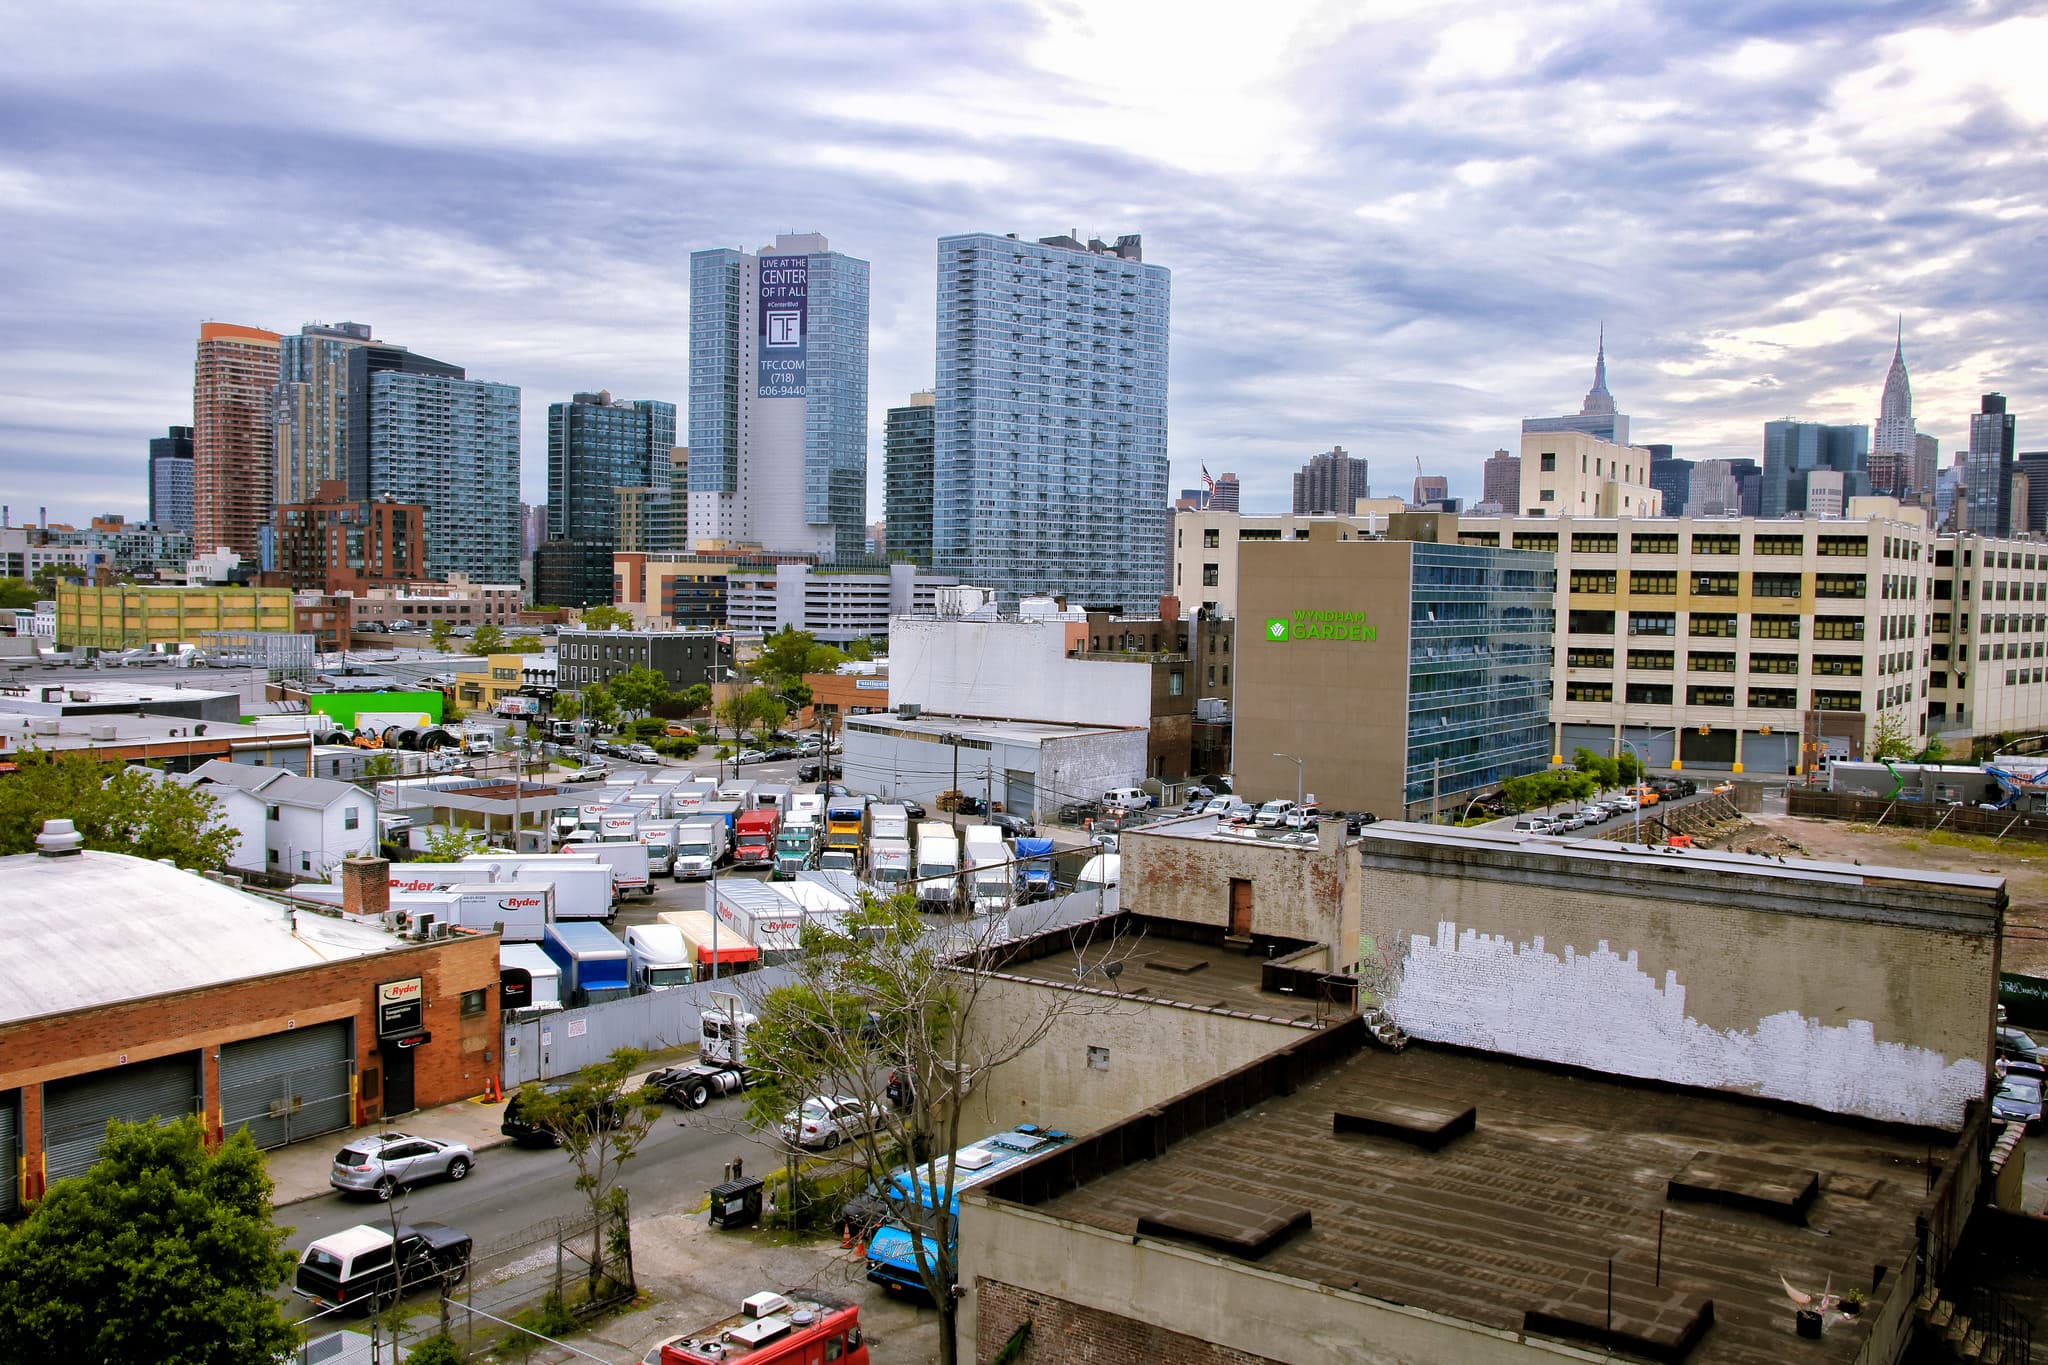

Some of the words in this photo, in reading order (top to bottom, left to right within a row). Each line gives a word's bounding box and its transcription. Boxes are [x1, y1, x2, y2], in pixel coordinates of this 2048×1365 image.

[762, 259, 778, 268] LIVE
[780, 259, 789, 268] AT
[792, 259, 806, 267] THE
[762, 269, 806, 285] CENTER
[762, 287, 776, 297] OF
[778, 287, 787, 296] IT
[788, 287, 806, 297] ALL
[761, 360, 805, 370] TFC.COM
[771, 373, 795, 384] (718)
[759, 386, 806, 396] 606-9440
[1293, 610, 1366, 623] WYNDHAM
[1293, 624, 1377, 641] GARDEN
[508, 897, 540, 909] Ryder
[718, 902, 733, 920] Ryder
[769, 921, 796, 931] Ryder
[392, 985, 418, 995] Ryder
